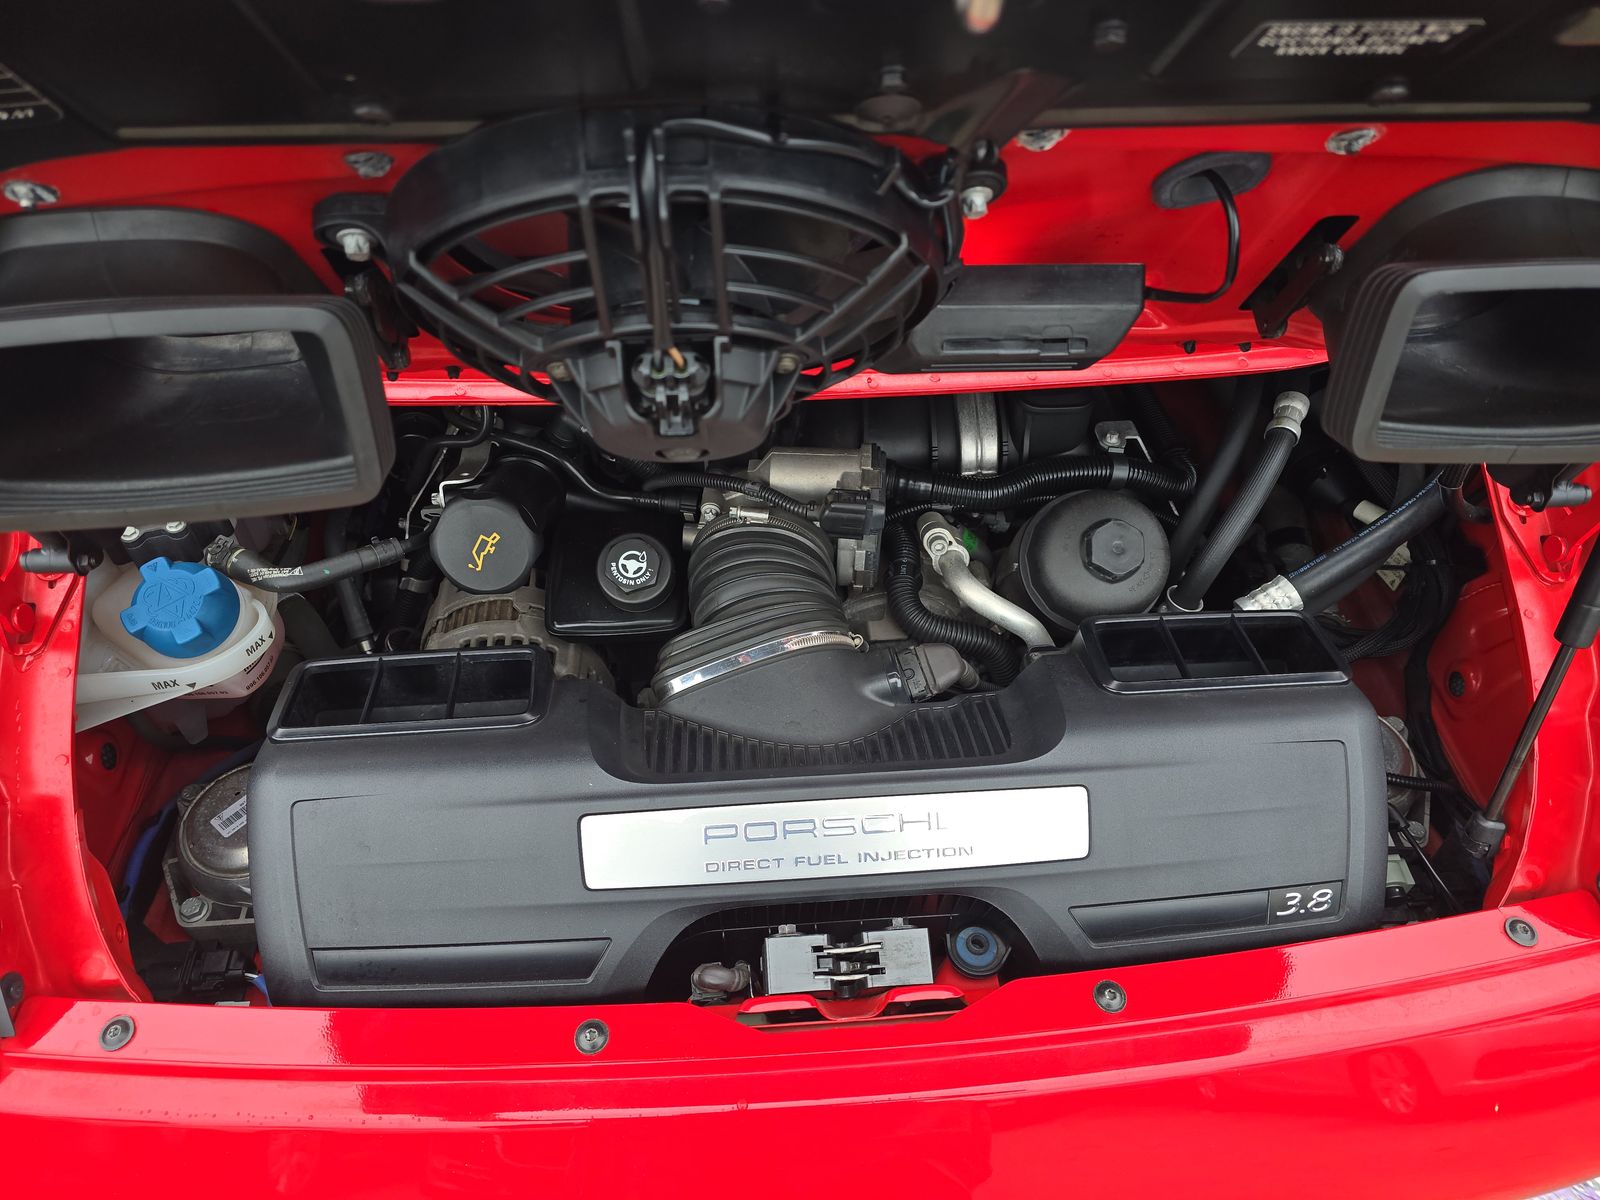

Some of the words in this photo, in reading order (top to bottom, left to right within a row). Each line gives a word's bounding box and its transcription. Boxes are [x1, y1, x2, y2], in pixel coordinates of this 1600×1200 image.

[610, 562, 635, 586] PENTOSIN
[245, 635, 266, 656] MAX
[151, 679, 180, 690] MAX
[705, 857, 785, 873] DIRECT
[794, 853, 849, 868] FUEL
[858, 845, 973, 864] INJECTION
[1276, 888, 1333, 916] 3.8
